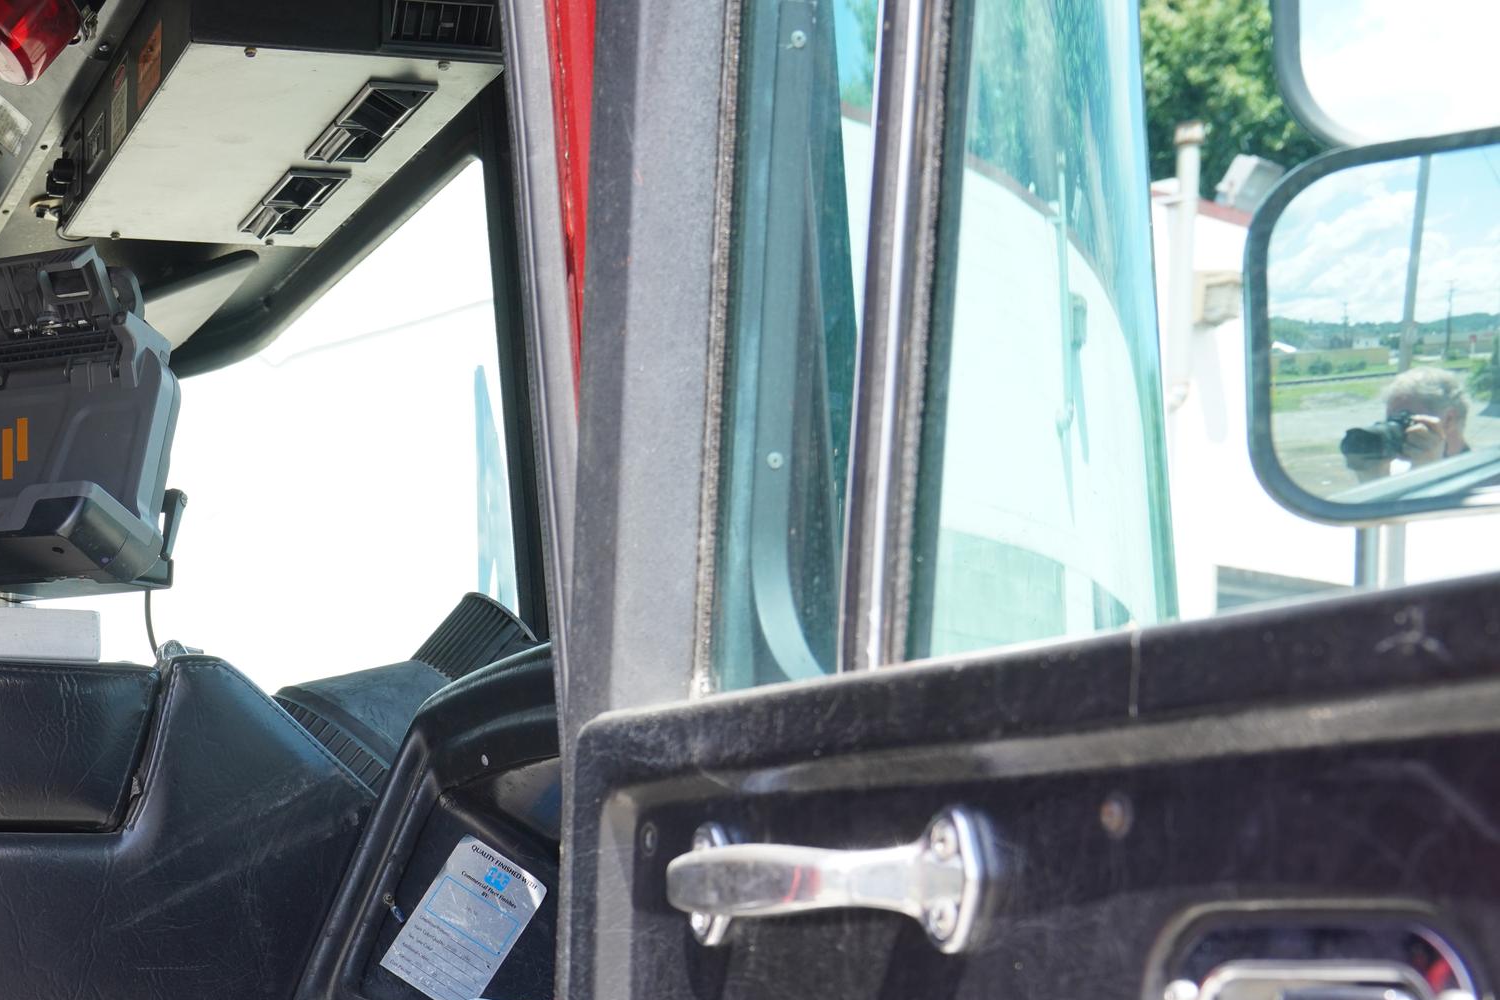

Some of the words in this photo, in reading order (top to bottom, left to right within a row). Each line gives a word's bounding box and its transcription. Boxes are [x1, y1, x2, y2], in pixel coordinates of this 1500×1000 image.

[471, 844, 495, 863] QUALITY
[495, 859, 521, 880] FINISHED
[461, 870, 488, 890] Commercial
